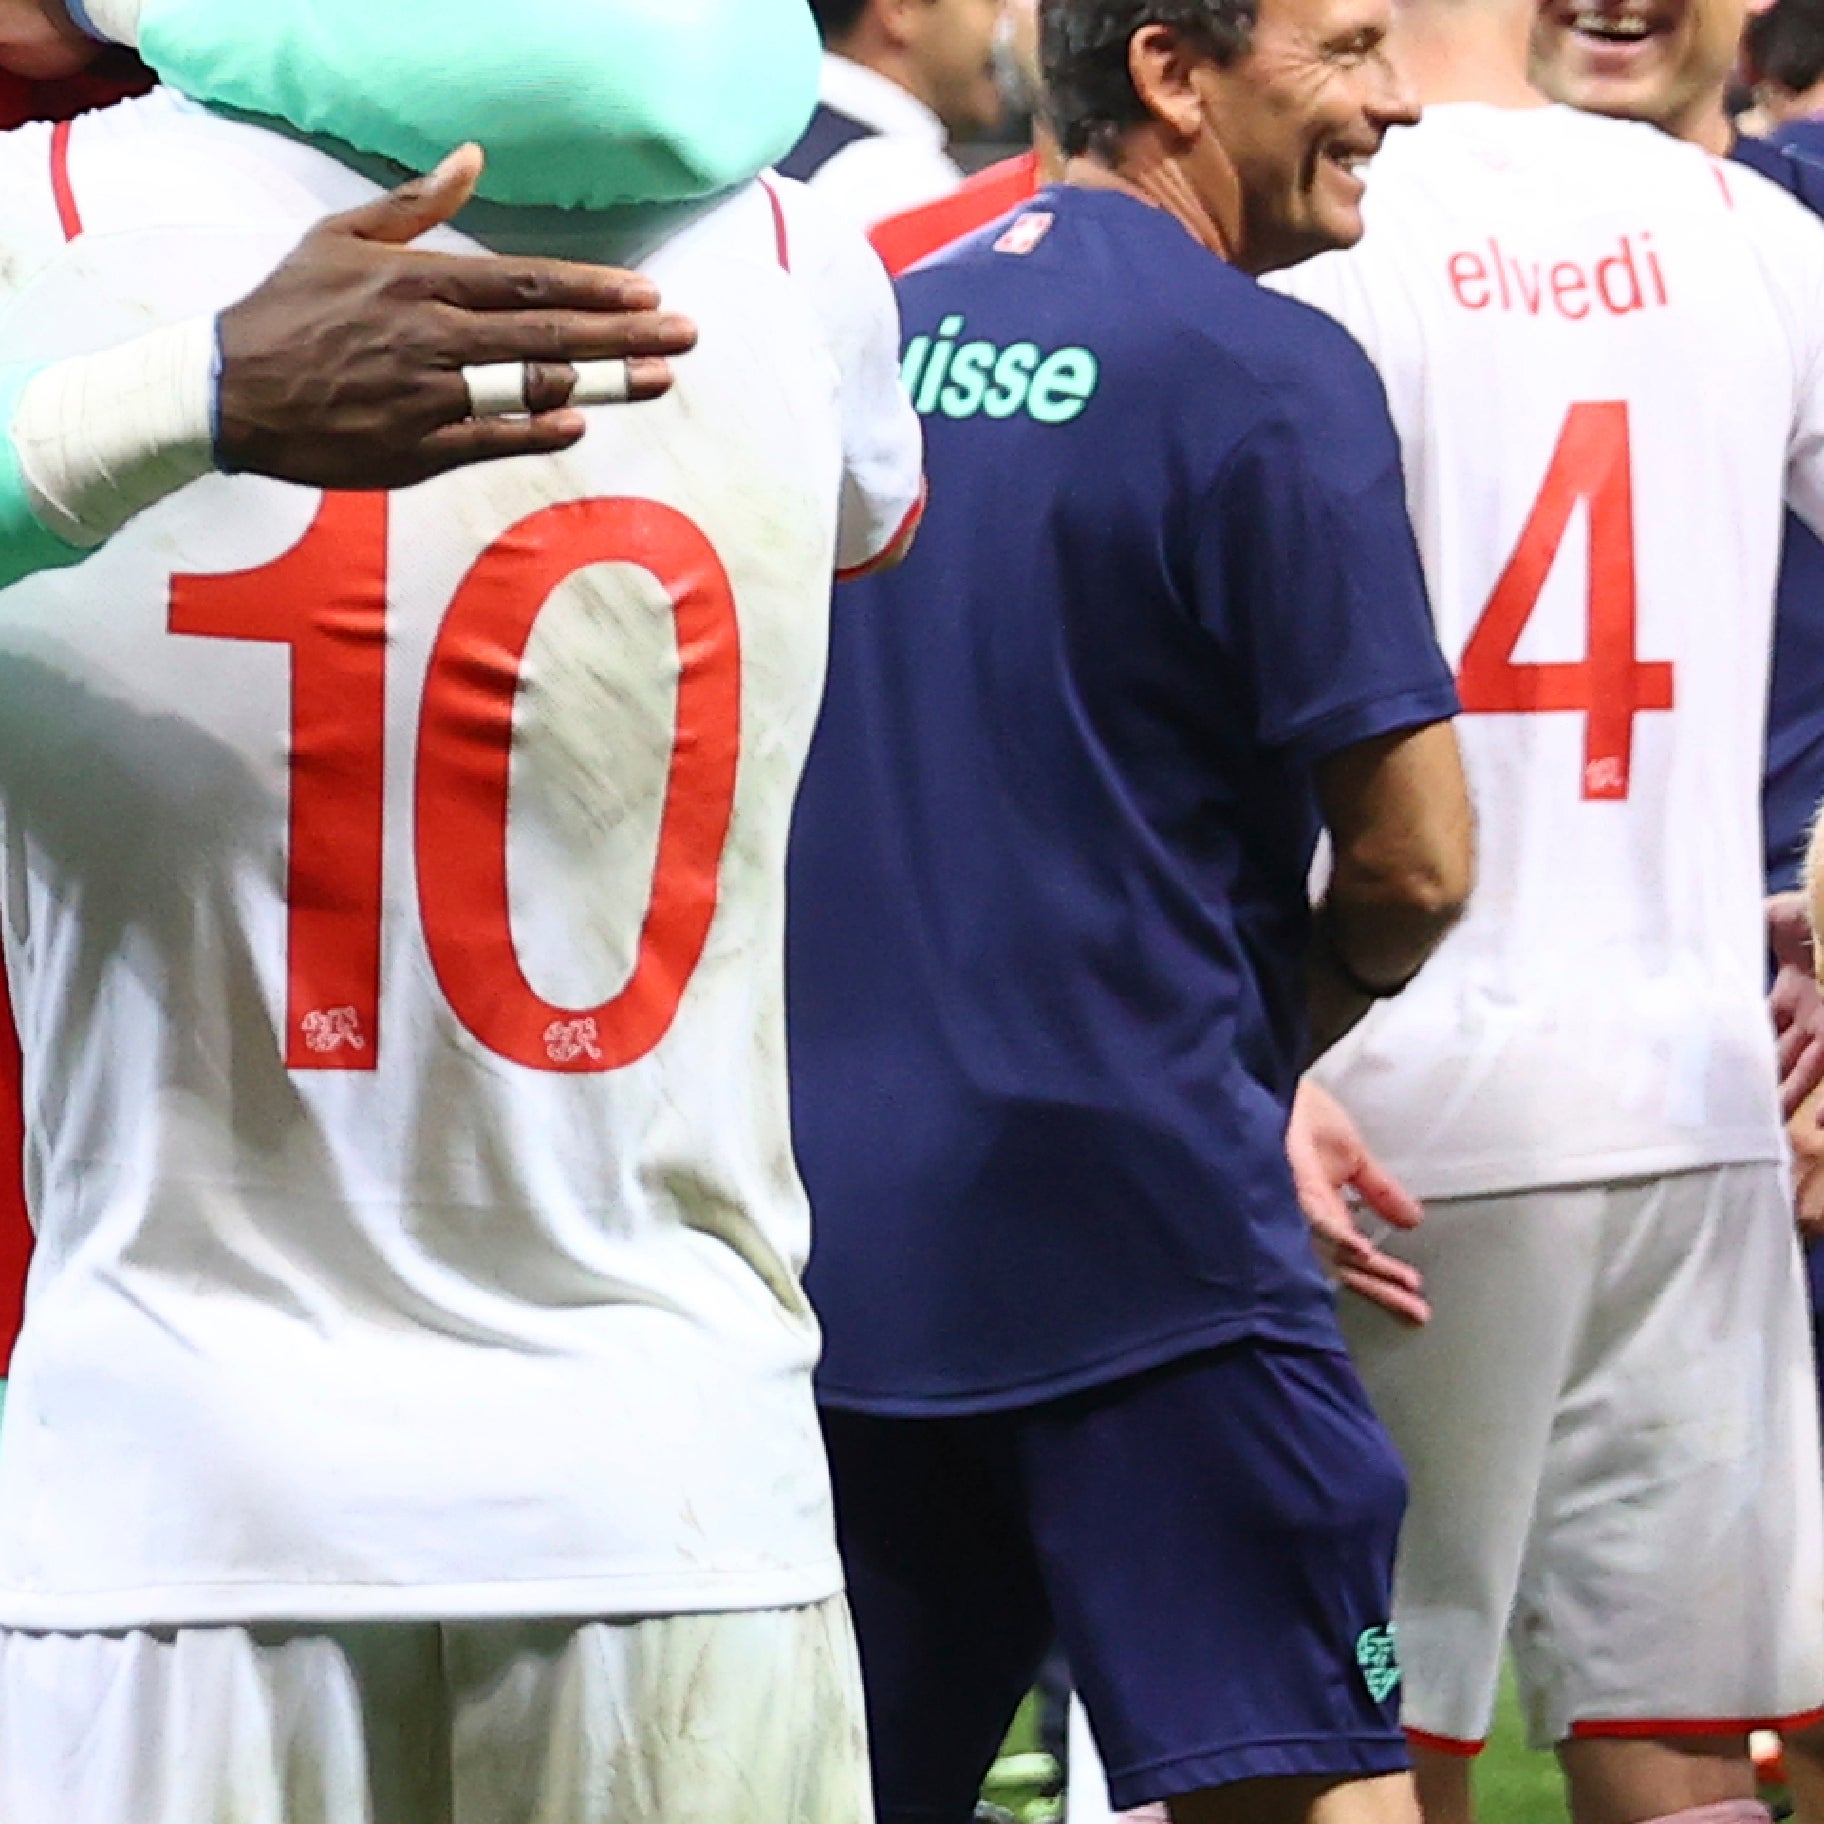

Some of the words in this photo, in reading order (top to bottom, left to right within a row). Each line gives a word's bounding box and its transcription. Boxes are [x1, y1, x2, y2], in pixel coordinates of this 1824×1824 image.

[1448, 232, 1668, 320] elvedi
[166, 488, 741, 1074] 10
[1459, 399, 1674, 802] 4
